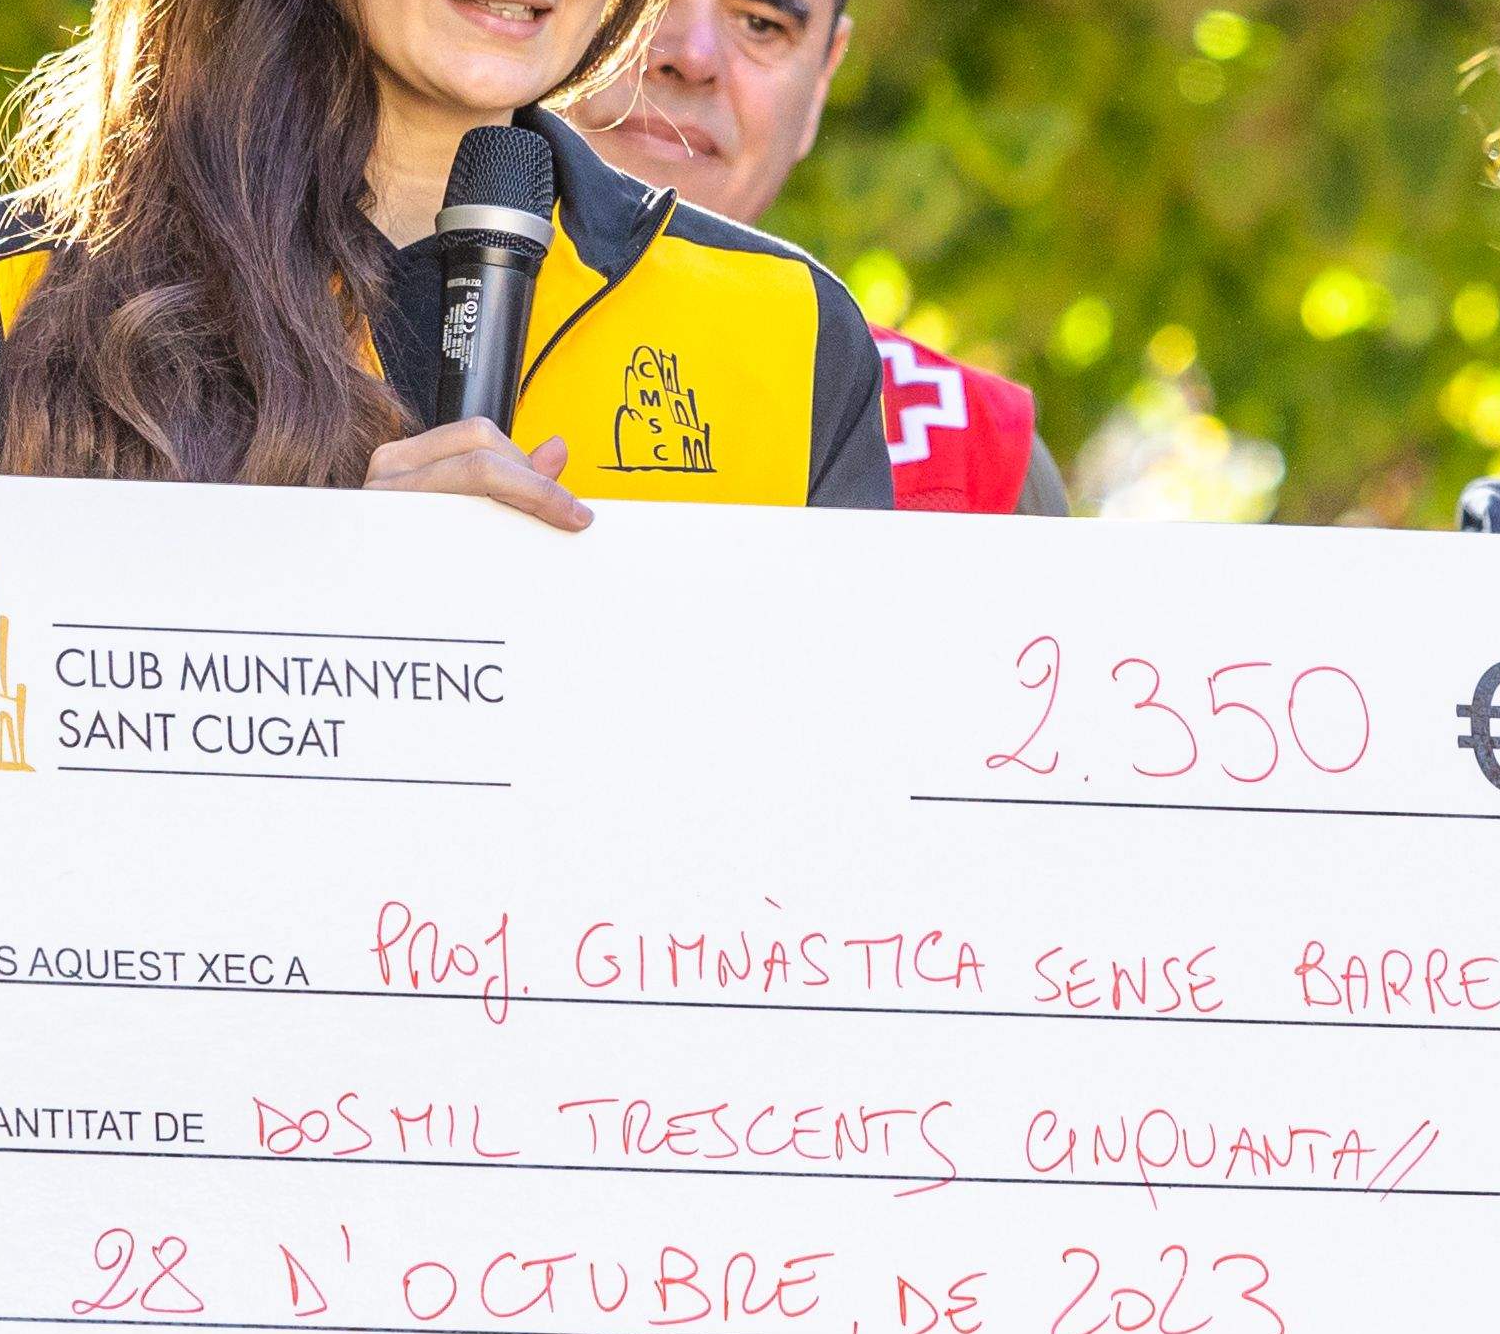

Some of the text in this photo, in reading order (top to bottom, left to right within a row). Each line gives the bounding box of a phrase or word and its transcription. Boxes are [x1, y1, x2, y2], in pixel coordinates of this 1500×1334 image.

[55, 648, 504, 703] CLUB MUNTANYENC
[984, 634, 1372, 784] 2.350
[58, 708, 345, 758] SANT CUGAT
[28, 947, 186, 982] AQUEST
[197, 953, 275, 985] XEC
[284, 956, 310, 986] A
[575, 895, 988, 994] GIMNÀSTICA
[1034, 945, 1224, 1014] SENSE
[154, 1112, 205, 1144] DE
[557, 1097, 958, 1198] TRESCENTS
[70, 1227, 205, 1316] 28
